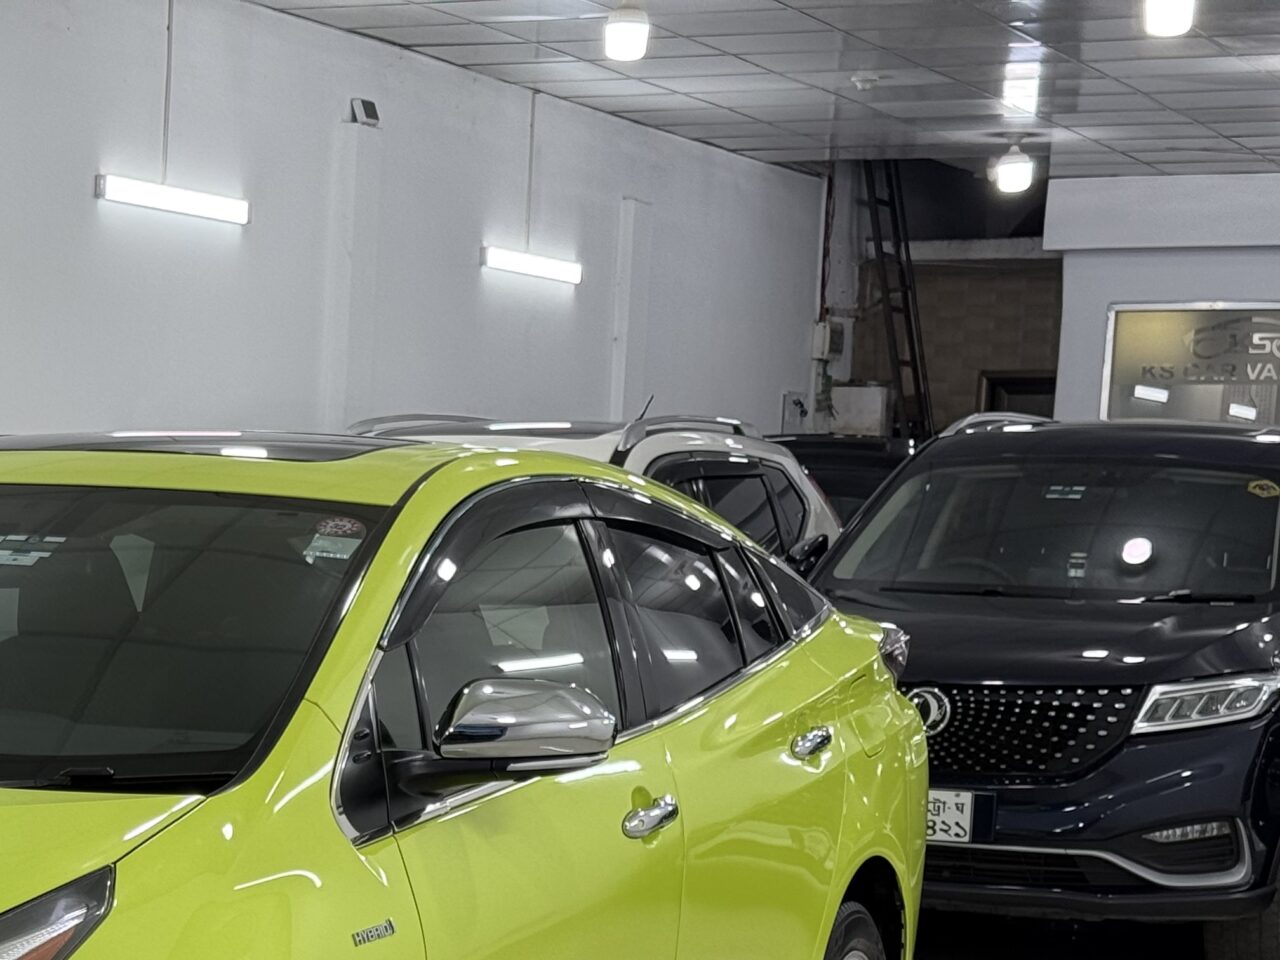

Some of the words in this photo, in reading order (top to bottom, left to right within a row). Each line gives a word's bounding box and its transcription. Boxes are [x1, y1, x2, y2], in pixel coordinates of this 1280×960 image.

[1141, 364, 1175, 380] KS
[1183, 362, 1238, 381] CAR
[353, 922, 394, 947] HYBRID
